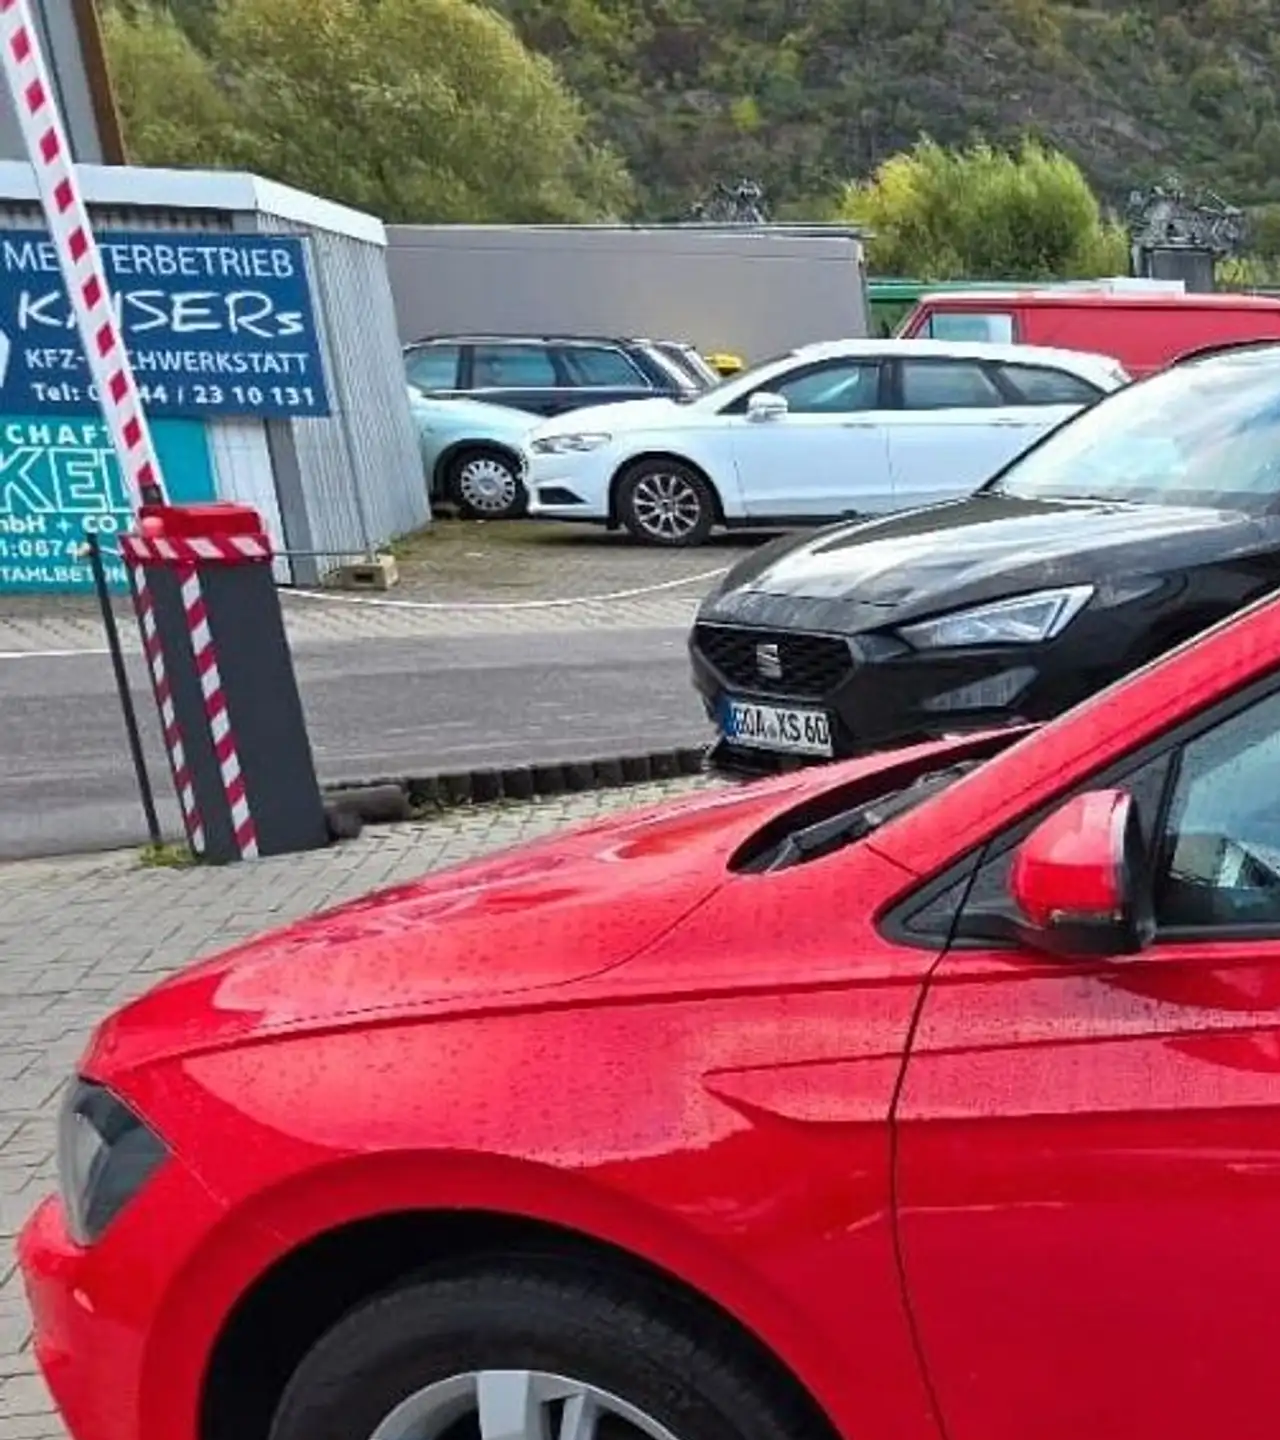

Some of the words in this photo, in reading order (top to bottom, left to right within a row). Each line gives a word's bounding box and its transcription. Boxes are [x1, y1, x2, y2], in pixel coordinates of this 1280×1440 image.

[3, 240, 294, 278] MEERBETRIEB
[18, 290, 304, 338] KISERs
[30, 382, 80, 402] Tel:
[88, 383, 169, 404] 044
[192, 383, 222, 405] 23
[234, 384, 262, 406] 10
[272, 386, 315, 407] 131
[82, 515, 118, 533] CO
